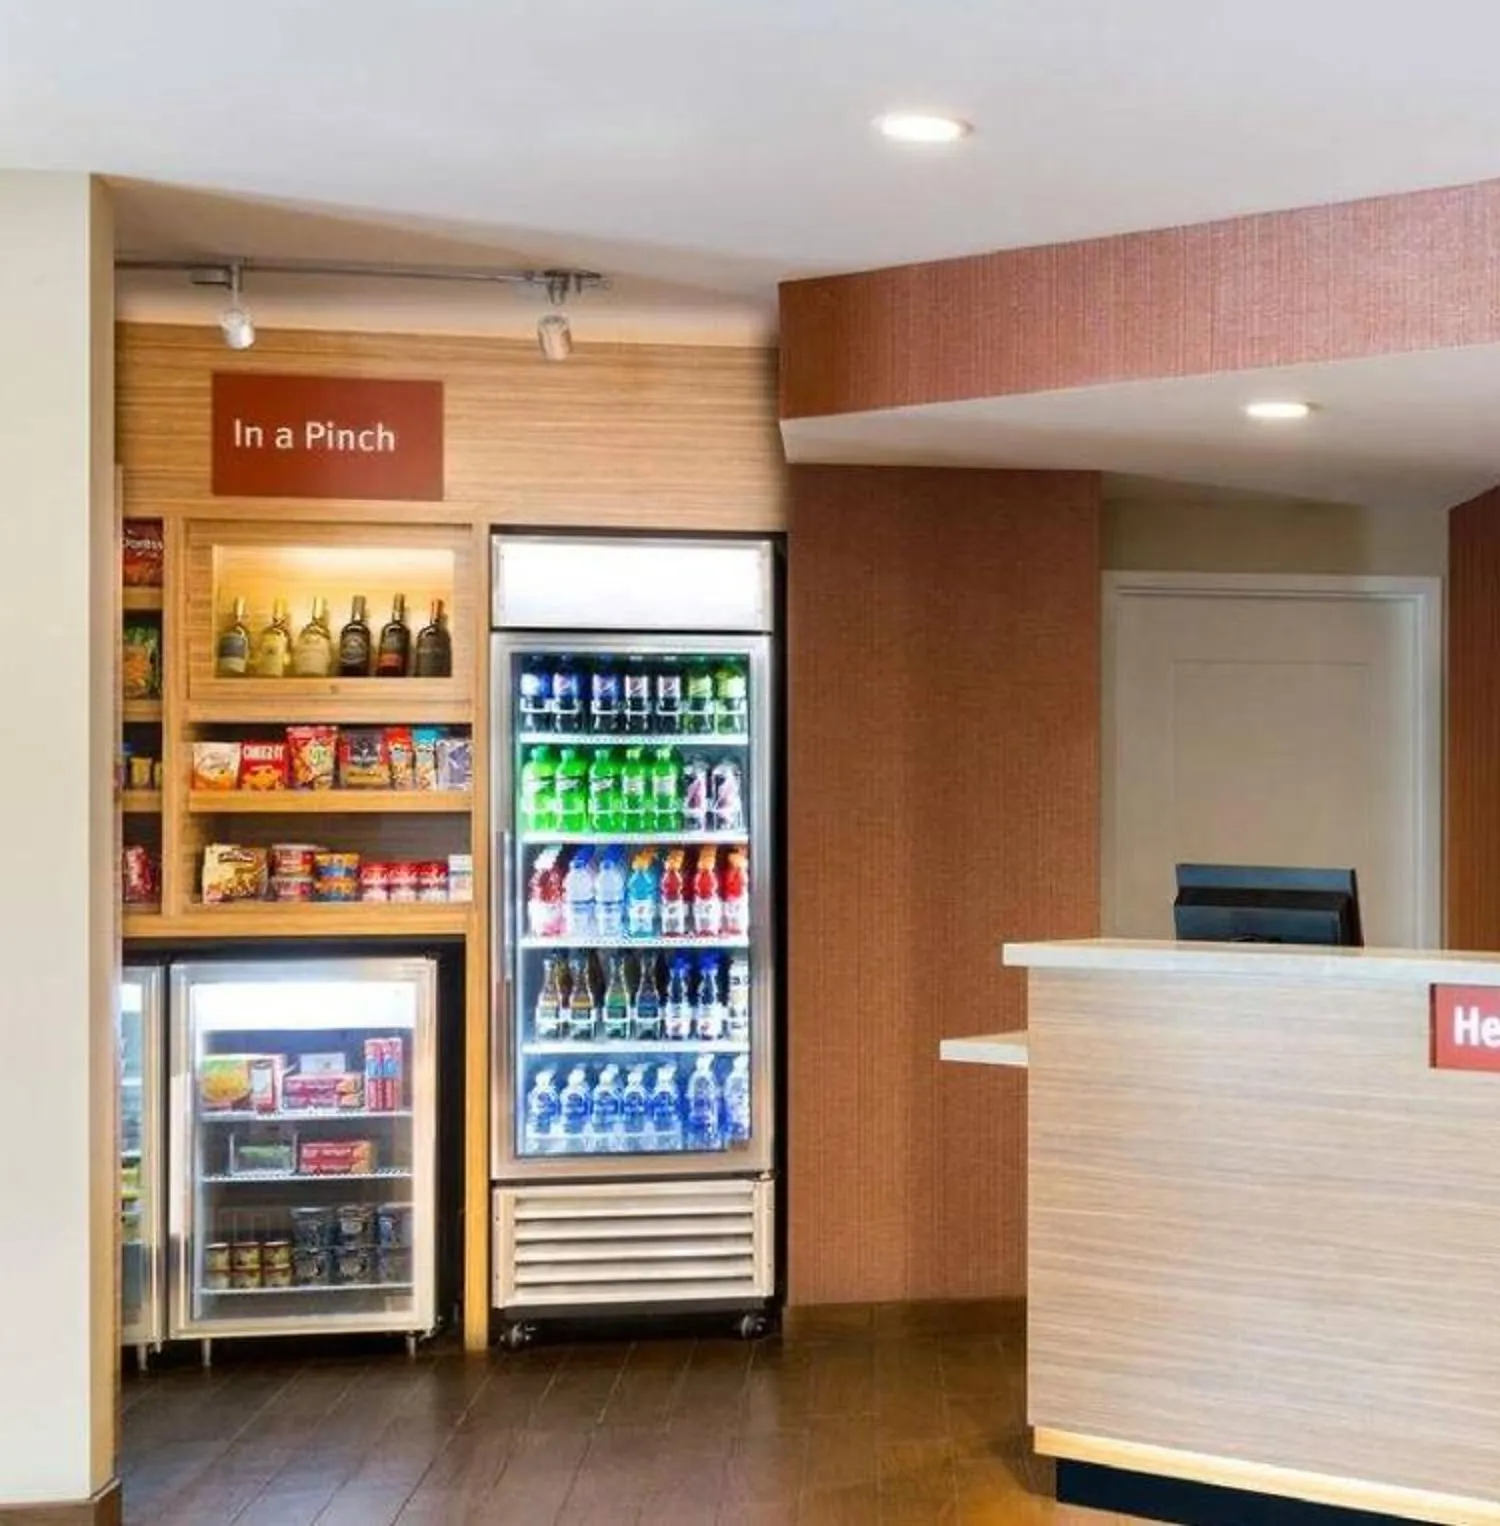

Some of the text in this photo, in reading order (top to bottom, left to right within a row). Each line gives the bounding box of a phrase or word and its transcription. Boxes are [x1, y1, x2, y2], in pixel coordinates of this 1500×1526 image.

[234, 418, 396, 452] In a Pinch
